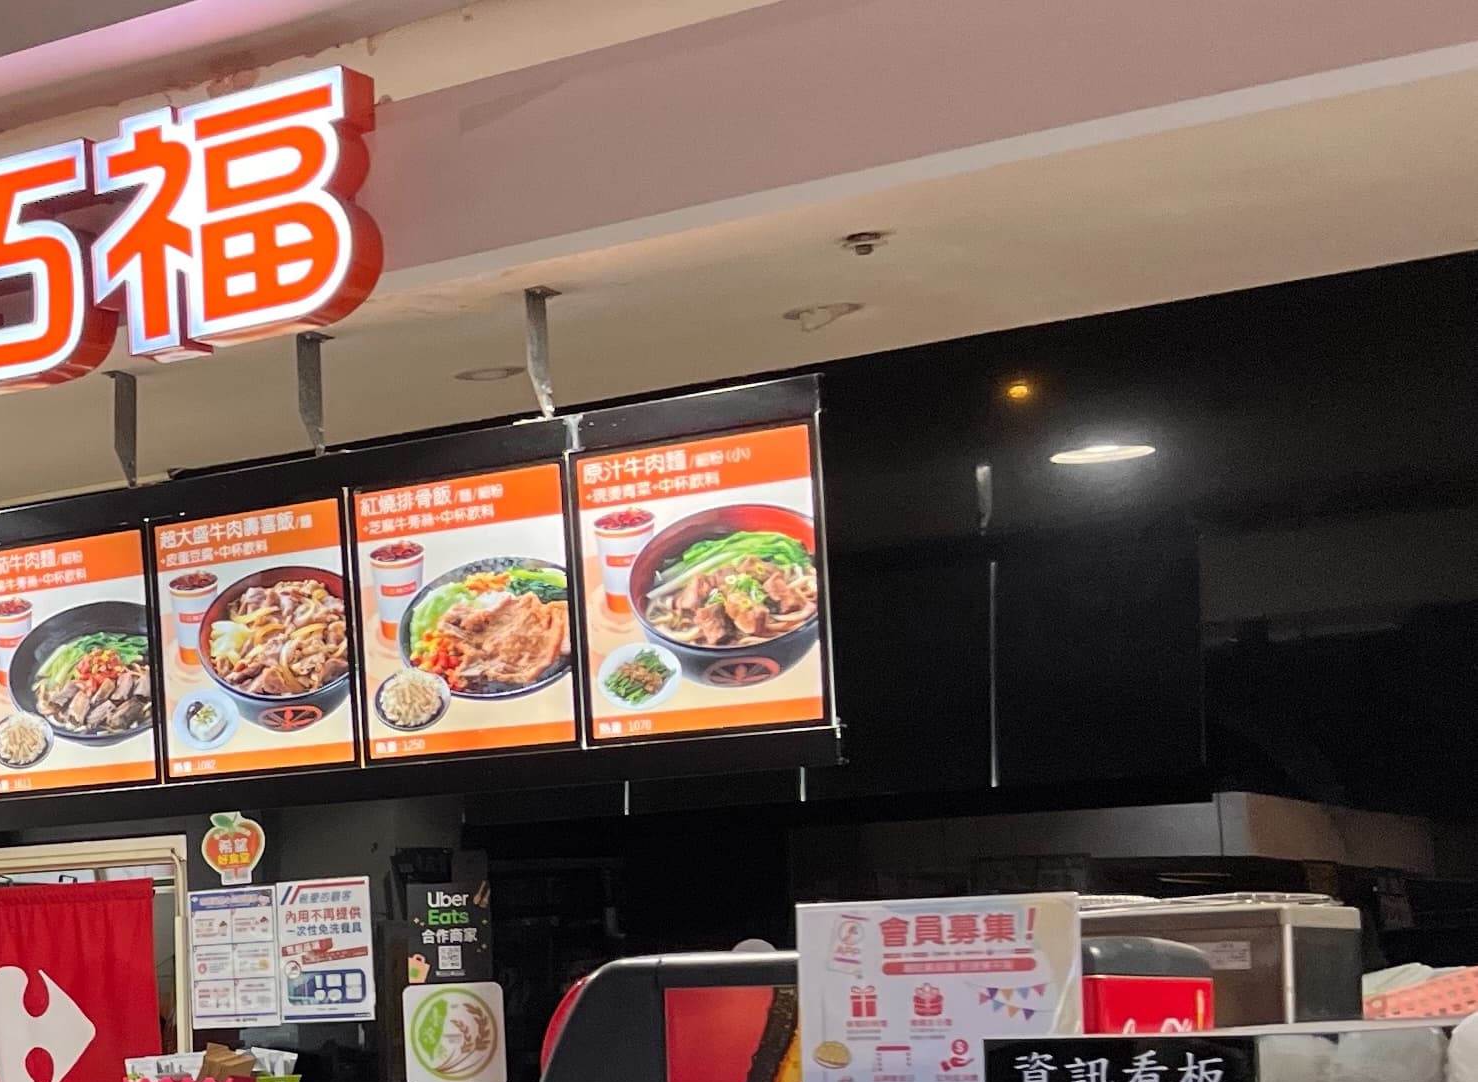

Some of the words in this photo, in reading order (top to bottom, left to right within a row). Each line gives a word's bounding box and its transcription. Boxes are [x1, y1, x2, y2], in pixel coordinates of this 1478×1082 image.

[427, 892, 469, 909] Uber
[285, 907, 362, 924] 內用不再提供
[427, 909, 470, 926] Eats
[286, 921, 363, 937] 一次性免洗餐具
[421, 927, 478, 944] 合作商家
